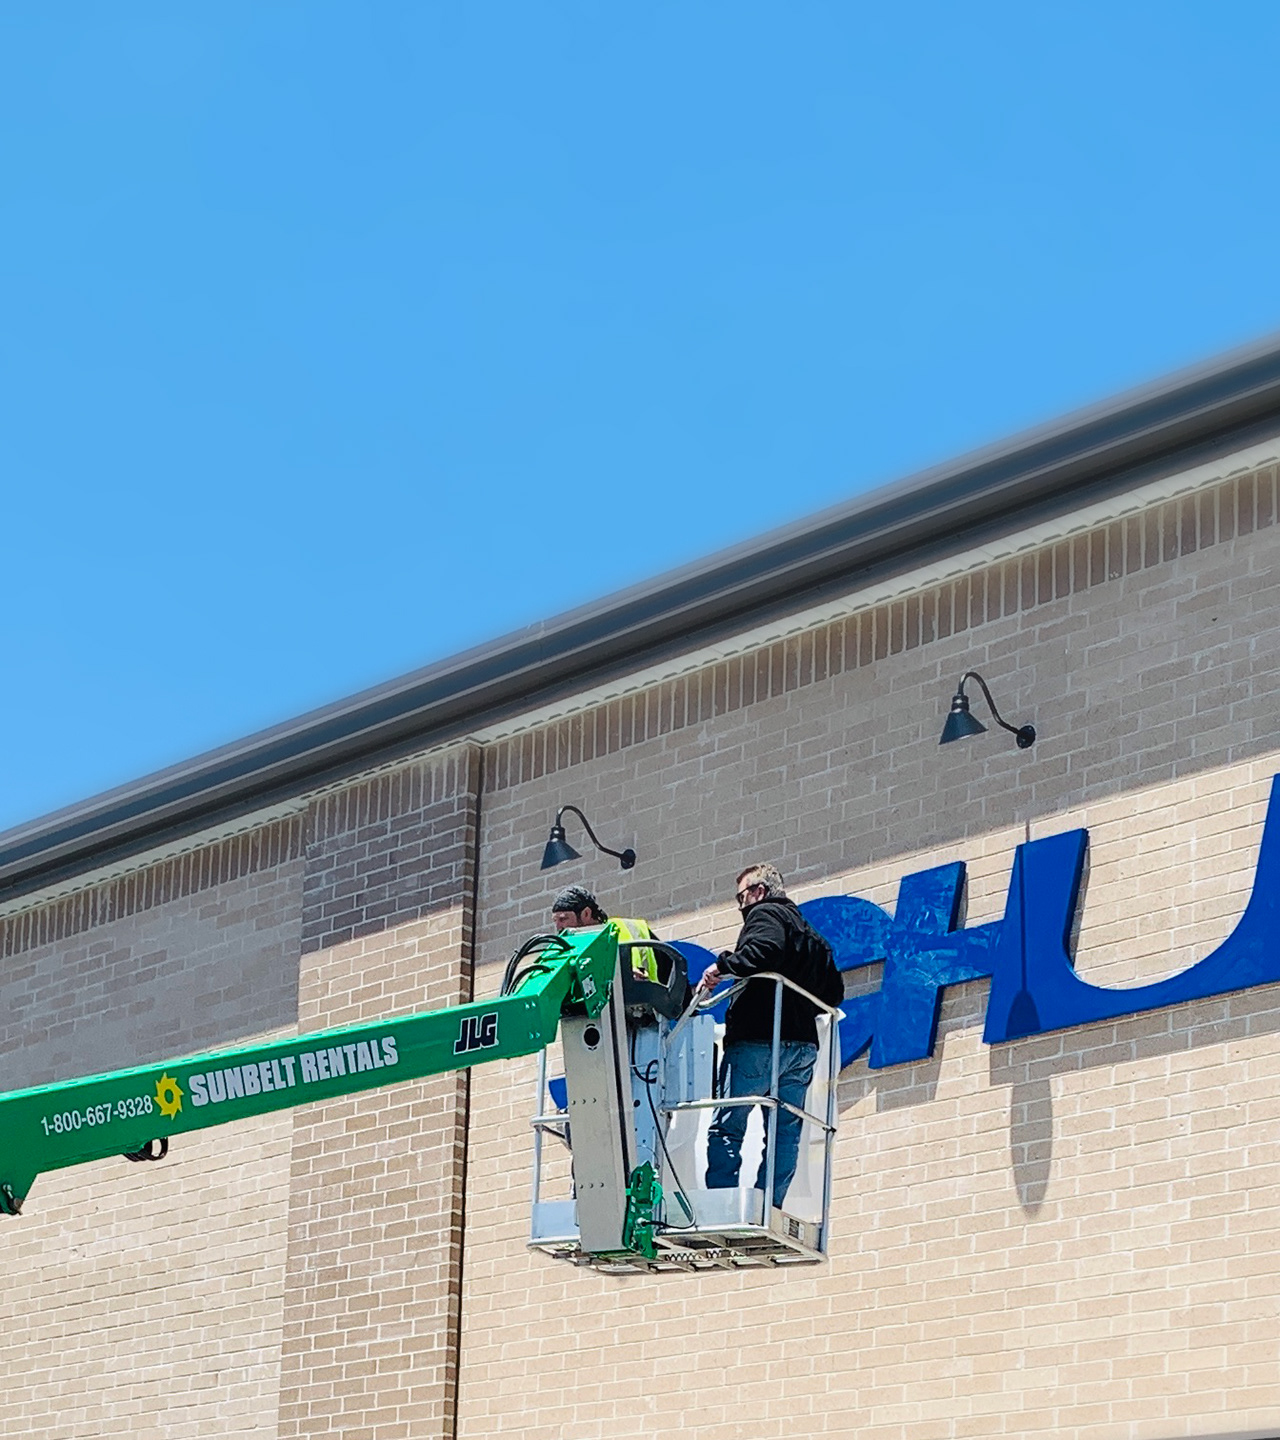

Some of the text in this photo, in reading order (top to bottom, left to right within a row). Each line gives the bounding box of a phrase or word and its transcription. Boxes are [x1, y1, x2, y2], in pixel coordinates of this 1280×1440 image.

[453, 1012, 498, 1055] JLG
[41, 1036, 399, 1136] 1-800-667-9328 SUNBELT RENTALS
